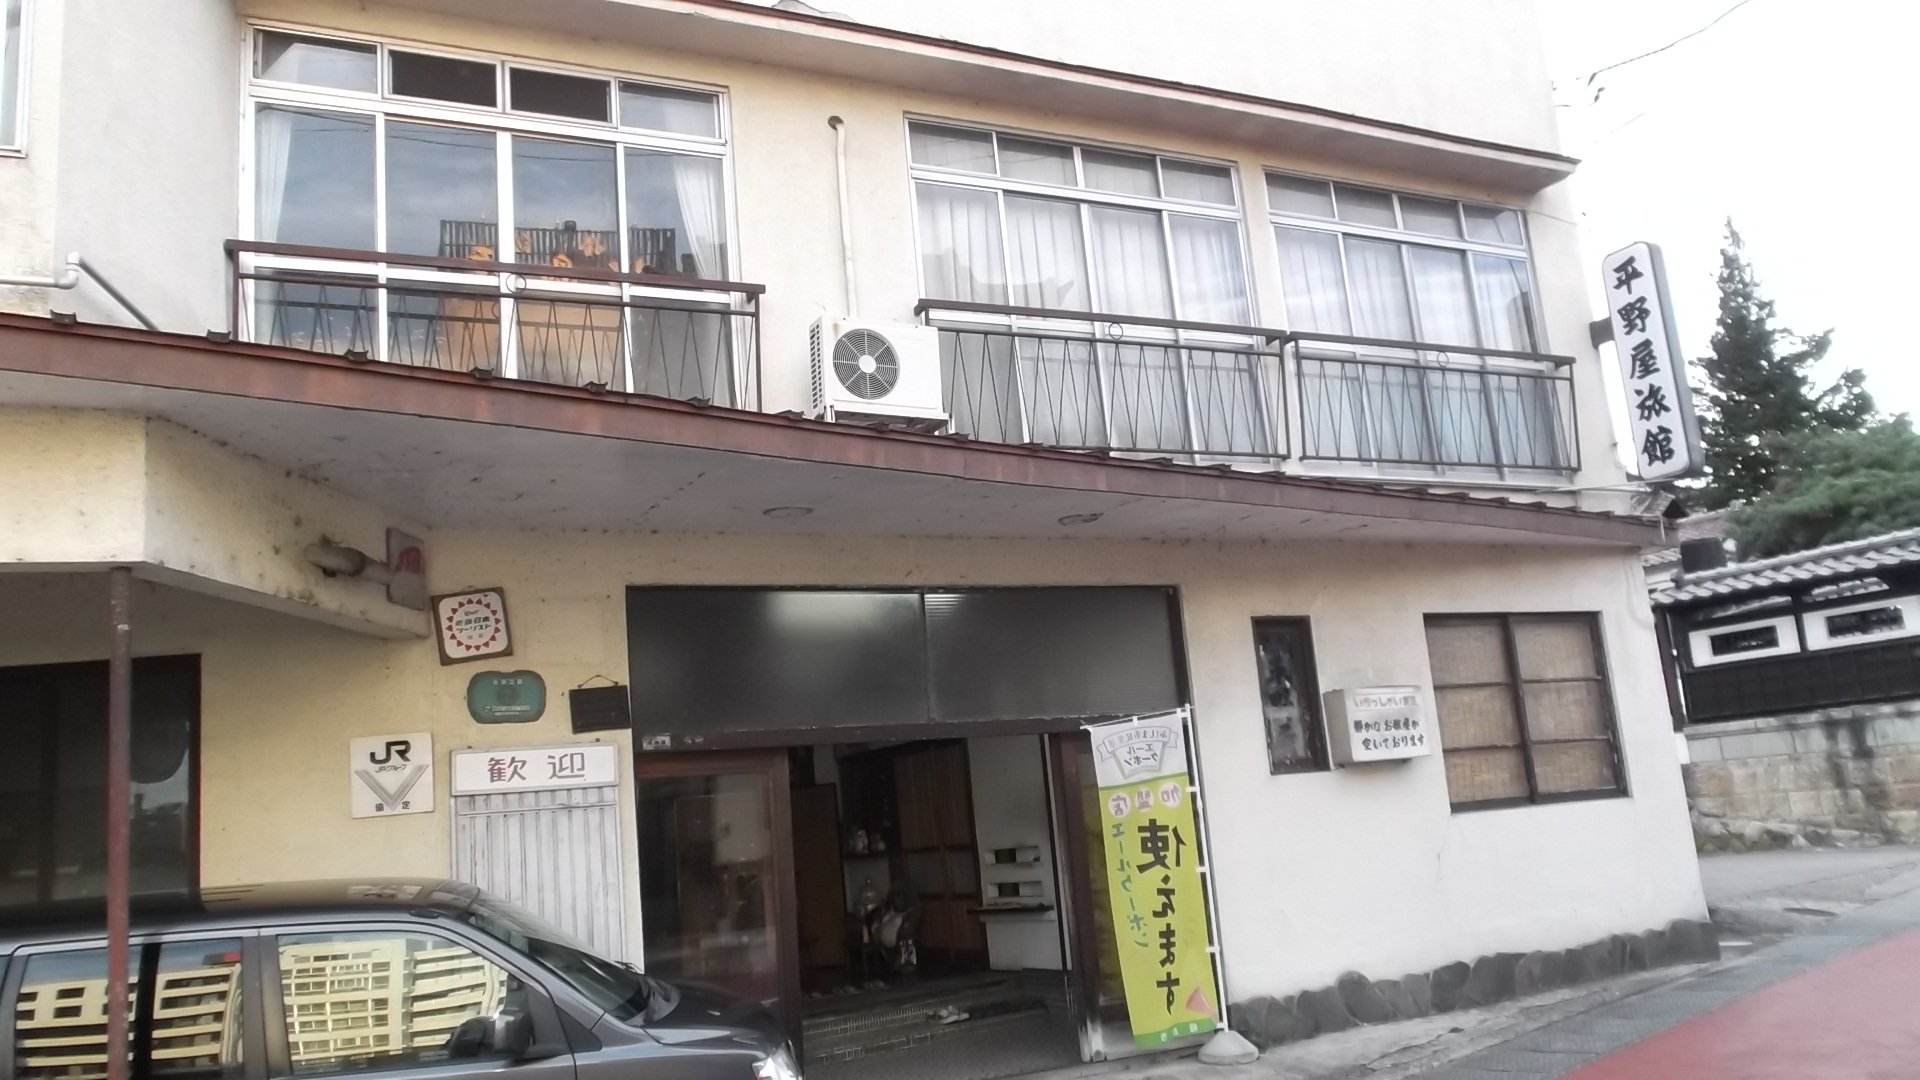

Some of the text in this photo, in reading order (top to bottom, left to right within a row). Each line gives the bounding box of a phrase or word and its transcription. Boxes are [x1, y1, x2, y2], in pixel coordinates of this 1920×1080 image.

[1612, 255, 1675, 467] 平野屋旅館
[369, 740, 411, 765] JR
[487, 752, 585, 783] 歓迎
